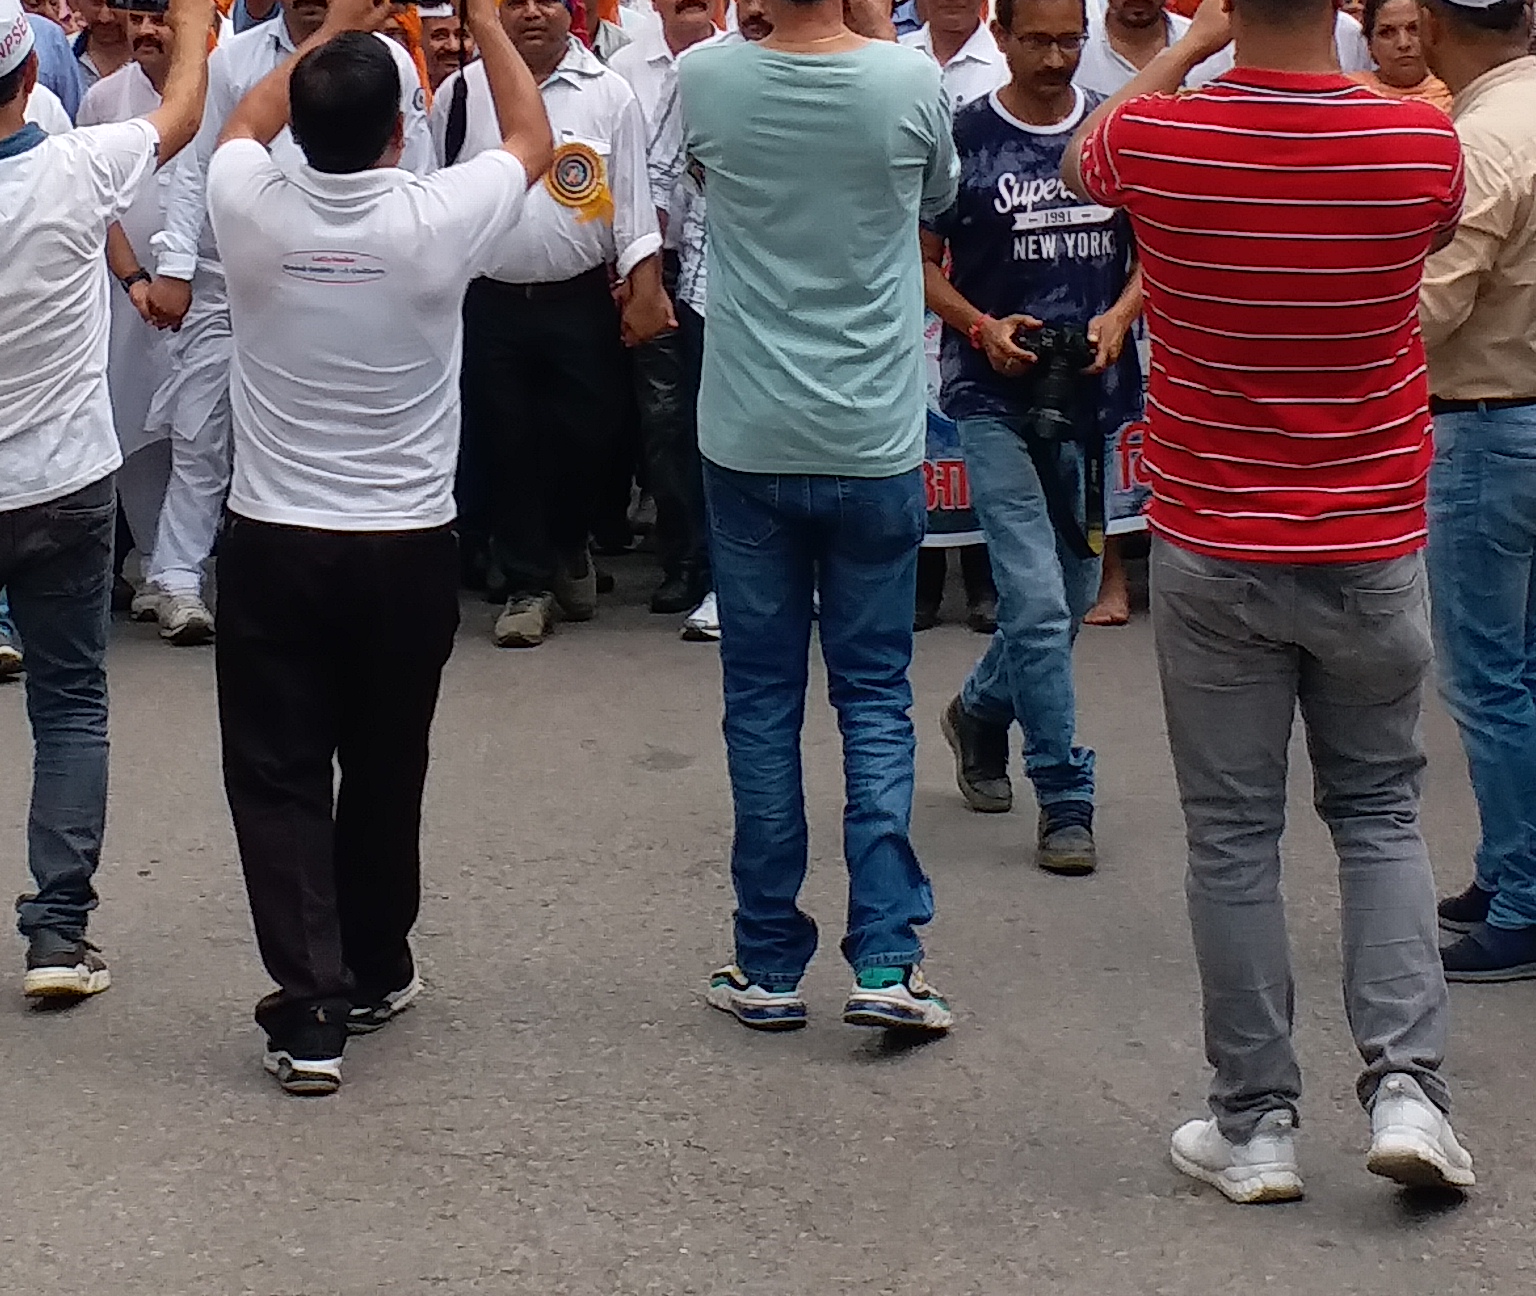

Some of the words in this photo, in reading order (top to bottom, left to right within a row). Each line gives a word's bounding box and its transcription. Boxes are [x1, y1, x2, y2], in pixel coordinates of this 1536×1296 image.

[1044, 210, 1072, 224] 1991
[1013, 234, 1057, 261] NEW
[1064, 230, 1117, 259] YORK
